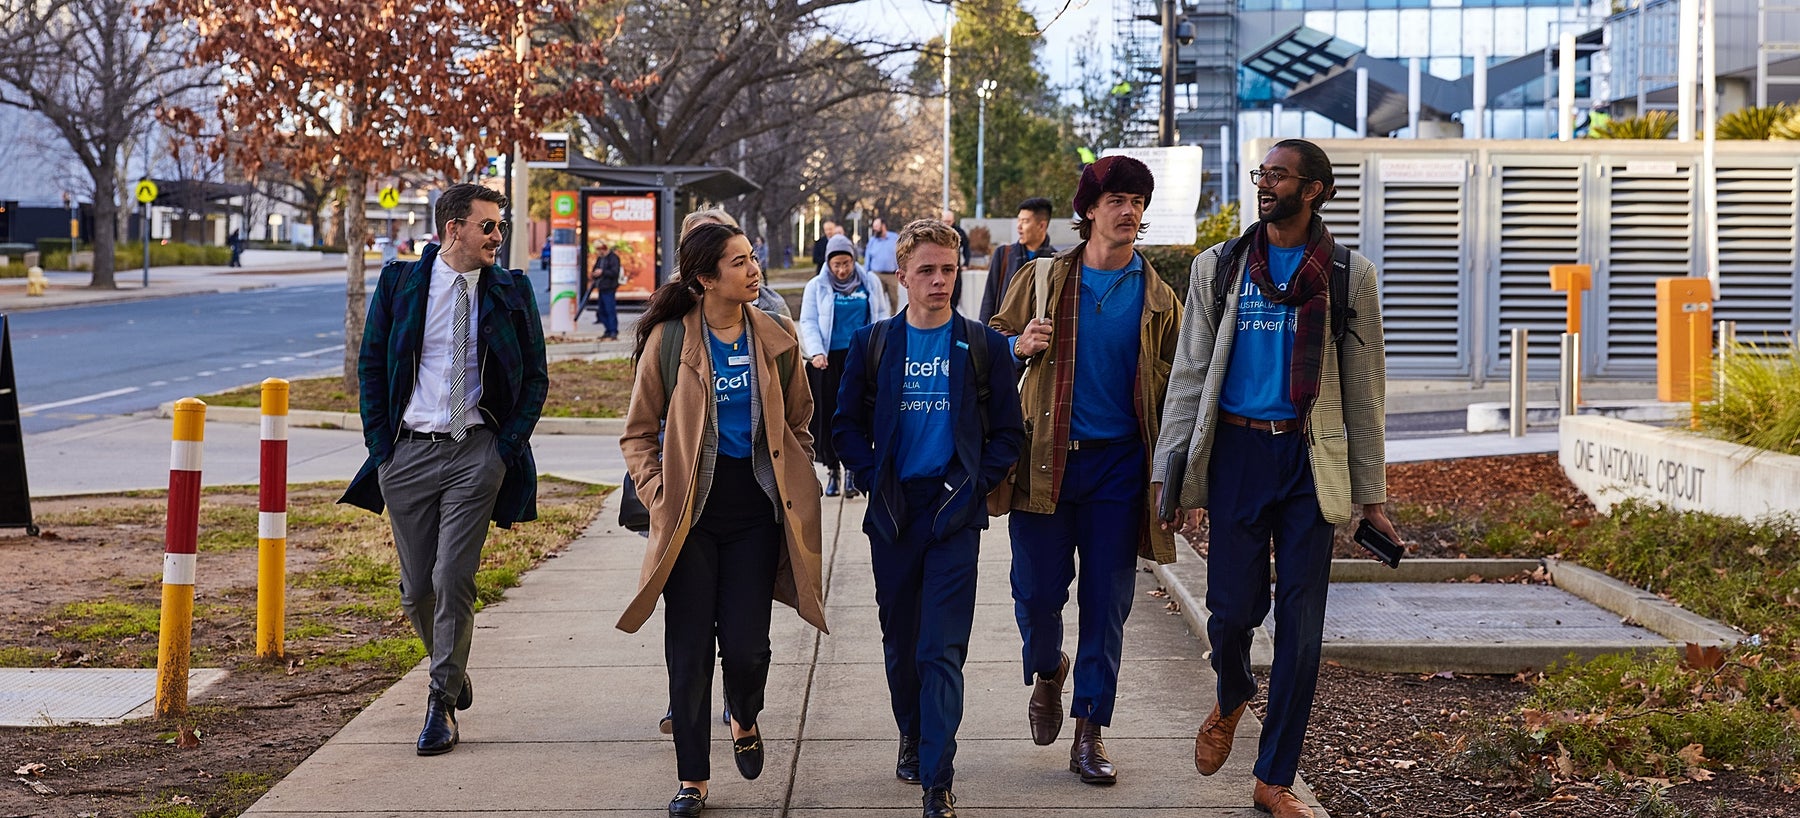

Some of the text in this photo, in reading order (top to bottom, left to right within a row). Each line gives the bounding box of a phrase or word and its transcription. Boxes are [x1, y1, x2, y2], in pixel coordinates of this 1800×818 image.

[1253, 320, 1284, 333] every
[904, 356, 941, 377] icef
[900, 400, 933, 414] every
[1574, 439, 1705, 503] ONE NATIONAL CIRCUIT
